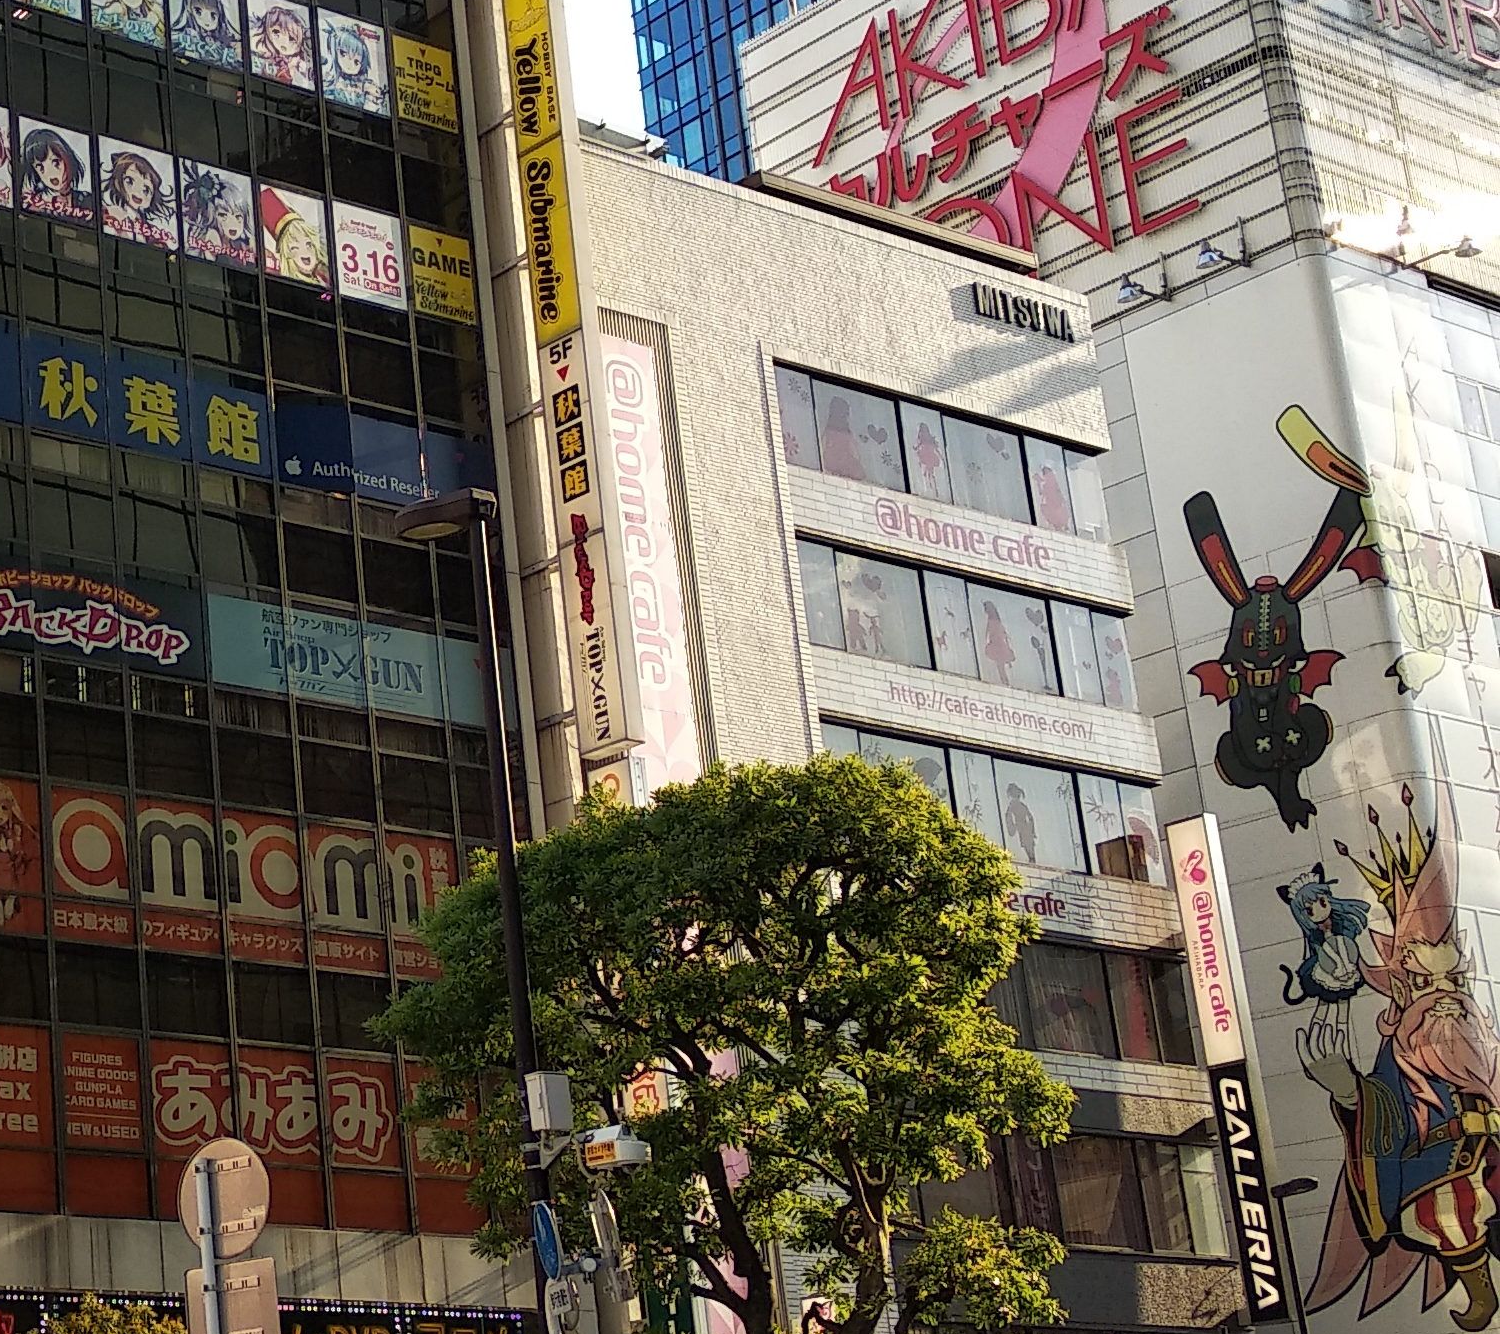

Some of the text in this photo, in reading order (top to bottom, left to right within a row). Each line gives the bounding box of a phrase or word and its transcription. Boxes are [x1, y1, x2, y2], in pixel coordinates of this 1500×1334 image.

[406, 56, 442, 77] TRPG
[399, 87, 432, 109] Yellow
[512, 37, 560, 325] Yellow Submarine
[341, 243, 400, 284] 3.16
[411, 246, 471, 279] GAME
[415, 280, 449, 301] Yellow
[975, 282, 1076, 344] MITSUWA
[548, 338, 573, 365] 5F
[38, 357, 261, 465] 秋葉館
[554, 385, 590, 504] 秋葉館
[606, 352, 673, 691] @home cafe
[875, 496, 1052, 573] @home cafe
[264, 636, 423, 695] TOP GUN
[888, 679, 1095, 742] http://cafe-athome.com/
[55, 800, 425, 932] amiami
[1024, 891, 1066, 920] cafe
[1191, 891, 1231, 1033] @home cafe
[71, 1051, 123, 1066] FIGURES
[97, 1068, 137, 1082] GOODS
[75, 1082, 124, 1096] GUNPLA
[96, 1097, 137, 1111] GAMES
[156, 1059, 388, 1159] あみあみ
[1218, 1076, 1282, 1311] GALLERIA
